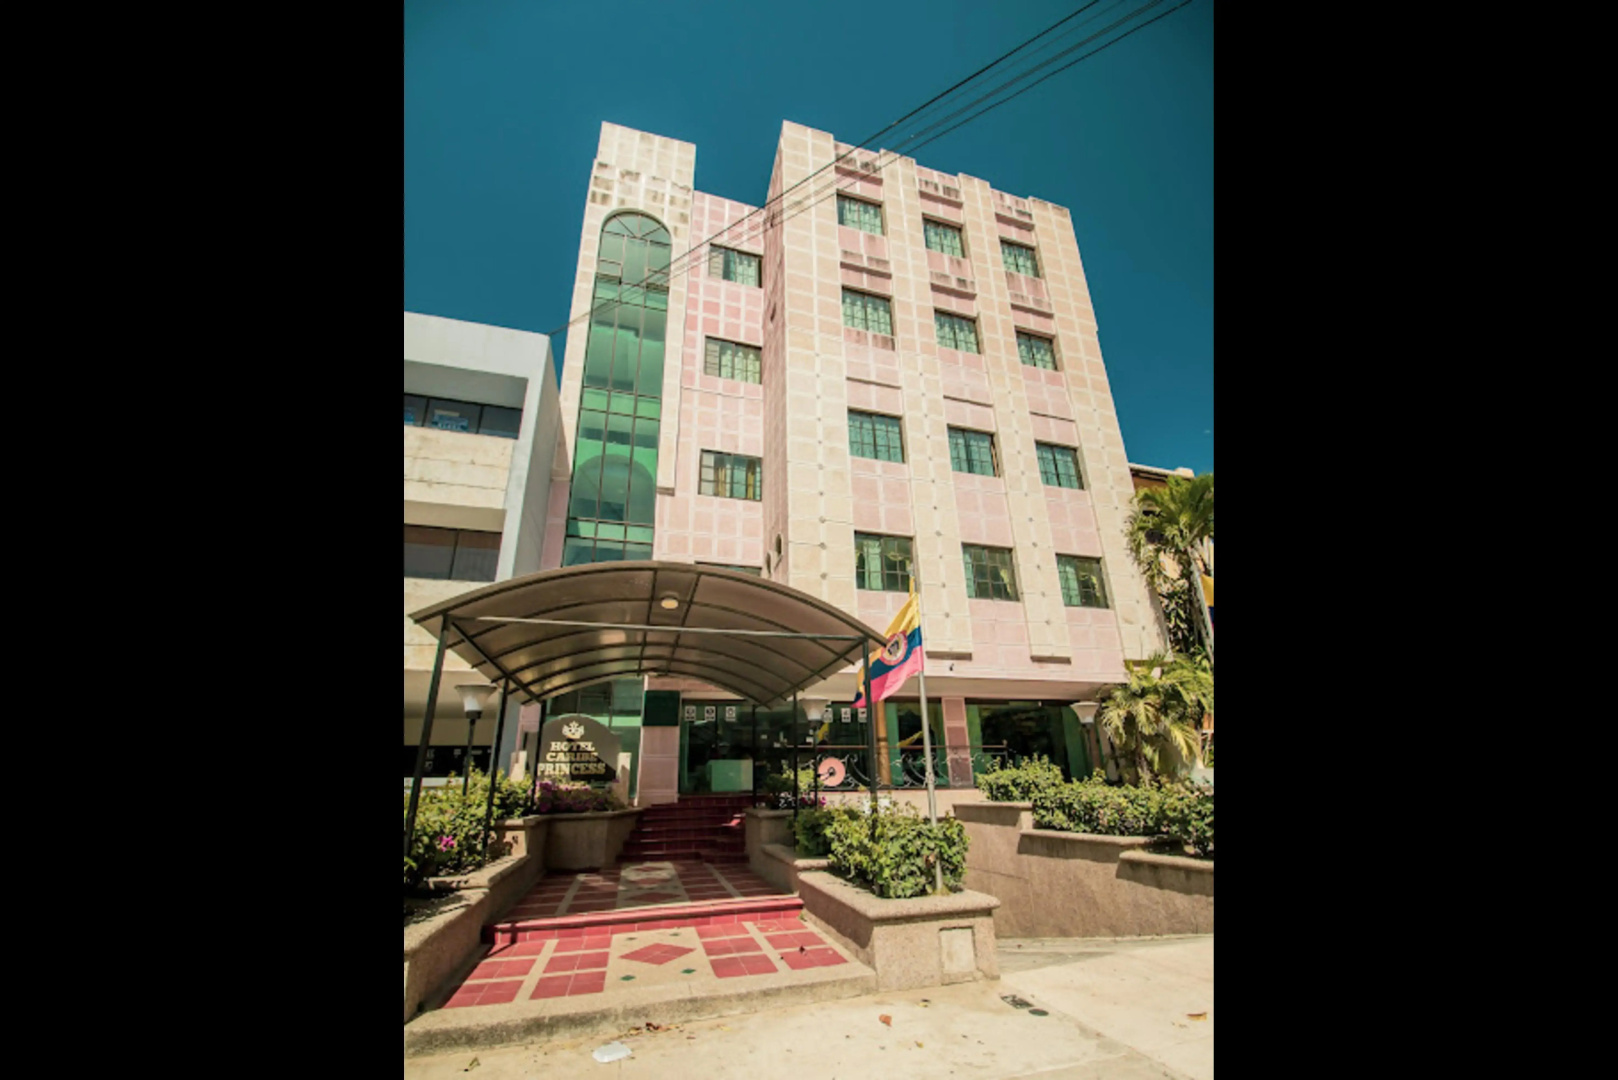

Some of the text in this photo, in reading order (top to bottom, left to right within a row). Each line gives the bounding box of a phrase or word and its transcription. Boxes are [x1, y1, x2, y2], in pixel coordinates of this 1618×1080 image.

[550, 741, 595, 751] HOTEL
[546, 752, 598, 762] CARIBE
[537, 763, 606, 776] PRINCESS
